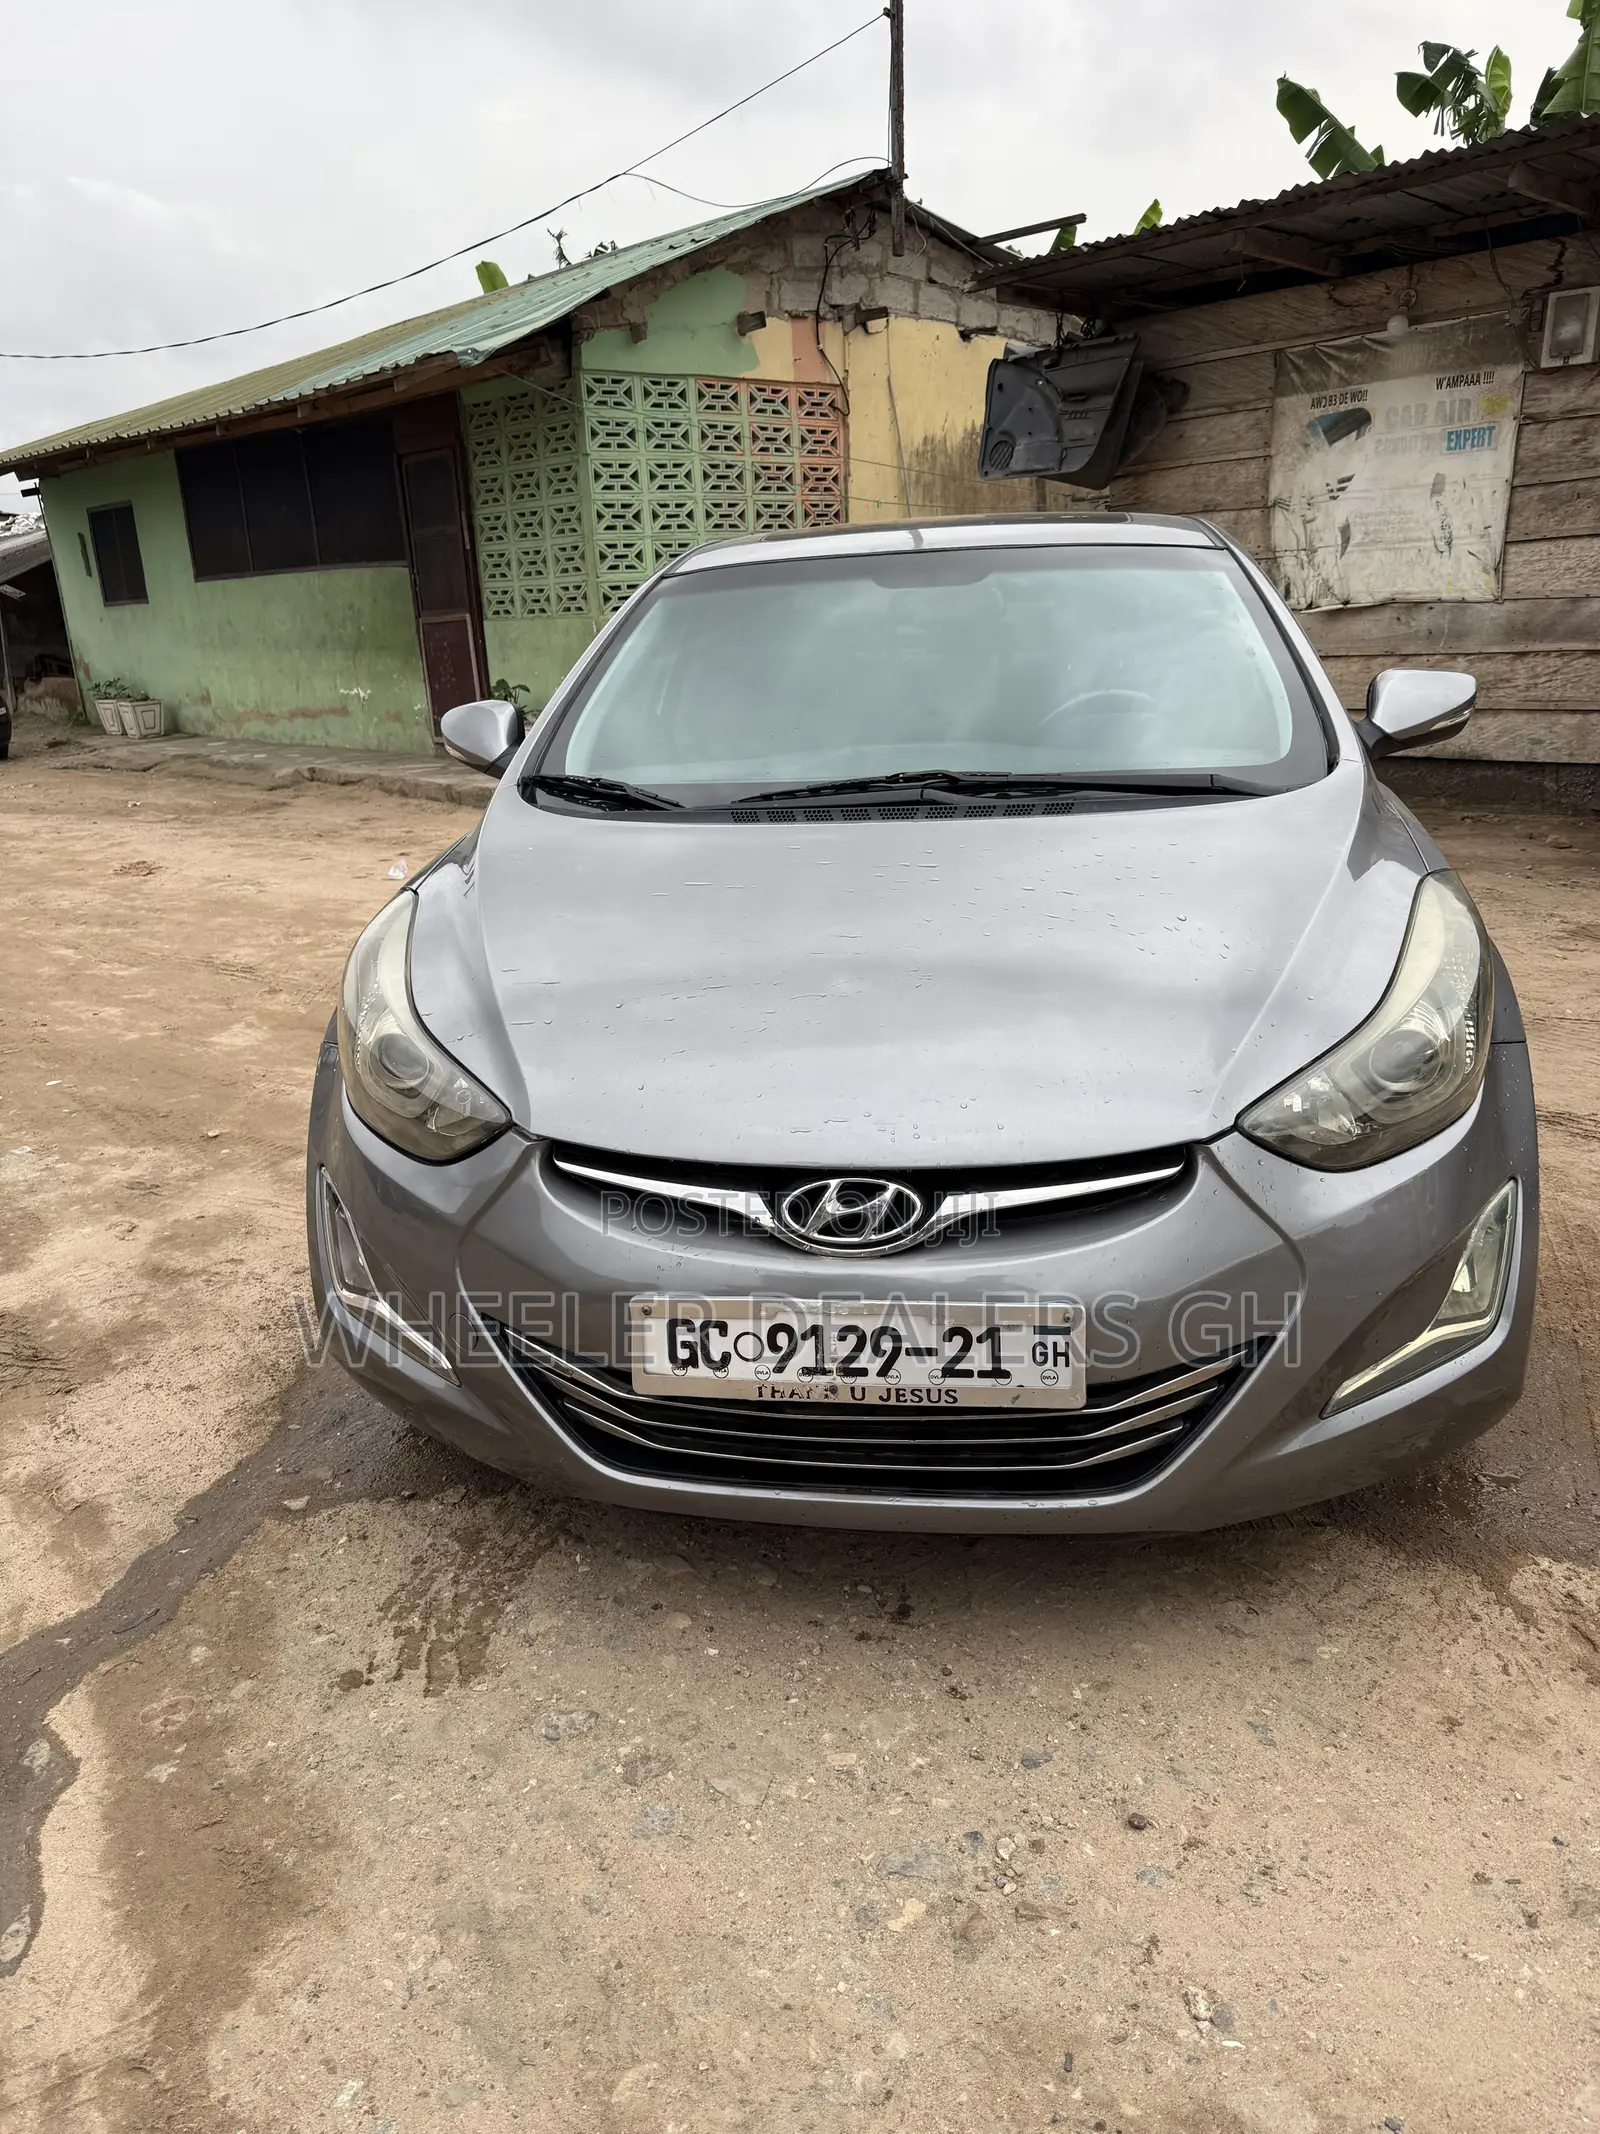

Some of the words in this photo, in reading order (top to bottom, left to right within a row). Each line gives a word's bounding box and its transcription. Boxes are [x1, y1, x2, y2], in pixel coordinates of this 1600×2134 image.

[1339, 393, 1348, 405] DE
[1350, 390, 1368, 403] WO!!
[1434, 398, 1471, 424] AIR
[1445, 426, 1496, 451] EXPERT
[667, 1318, 732, 1369] GC
[767, 1322, 1011, 1378] 9129-21
[1031, 1340, 1071, 1368] GH
[850, 1386, 866, 1401] U
[878, 1388, 958, 1404] JESUS
